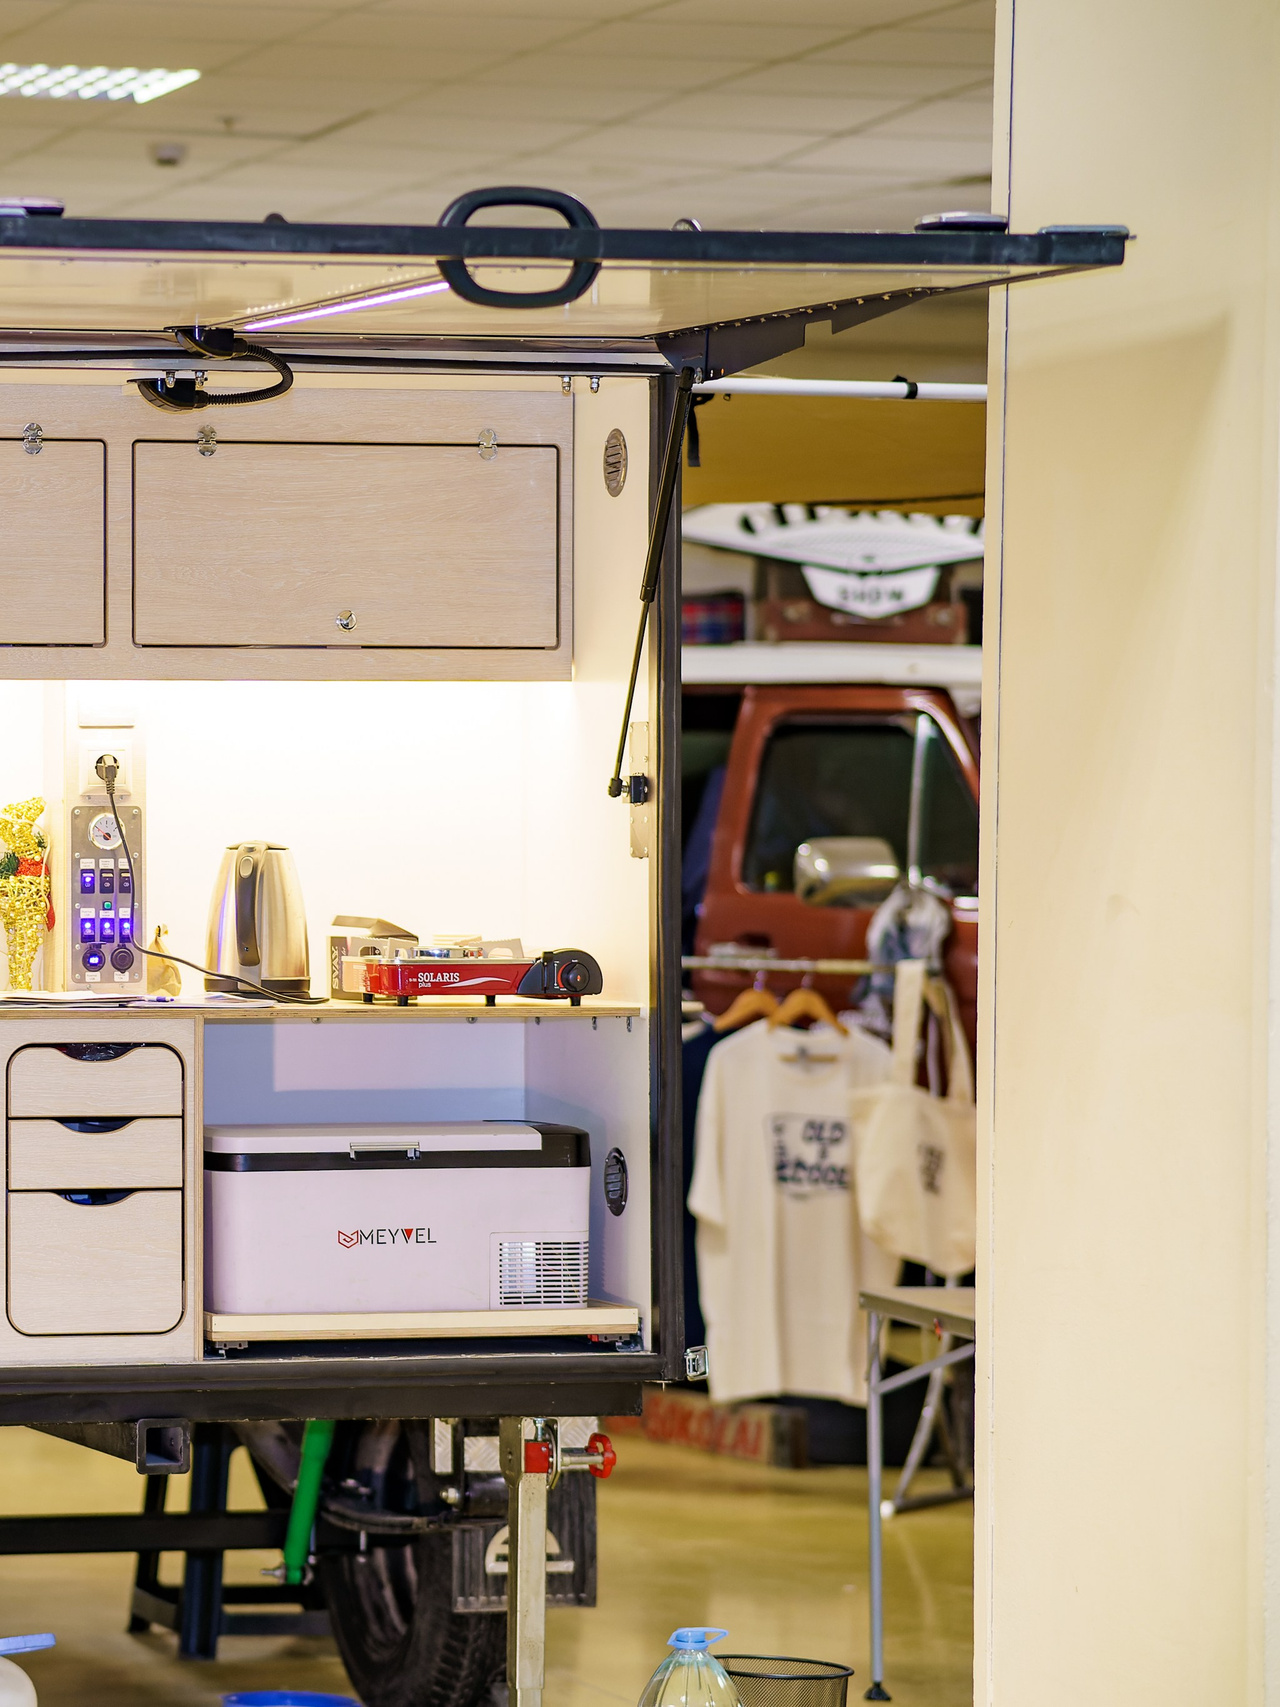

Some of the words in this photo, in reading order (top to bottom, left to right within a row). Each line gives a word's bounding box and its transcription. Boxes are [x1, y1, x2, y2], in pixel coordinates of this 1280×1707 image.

[417, 972, 460, 983] SOLARIS
[418, 981, 432, 989] plus
[359, 1227, 437, 1245] MEYVEL
